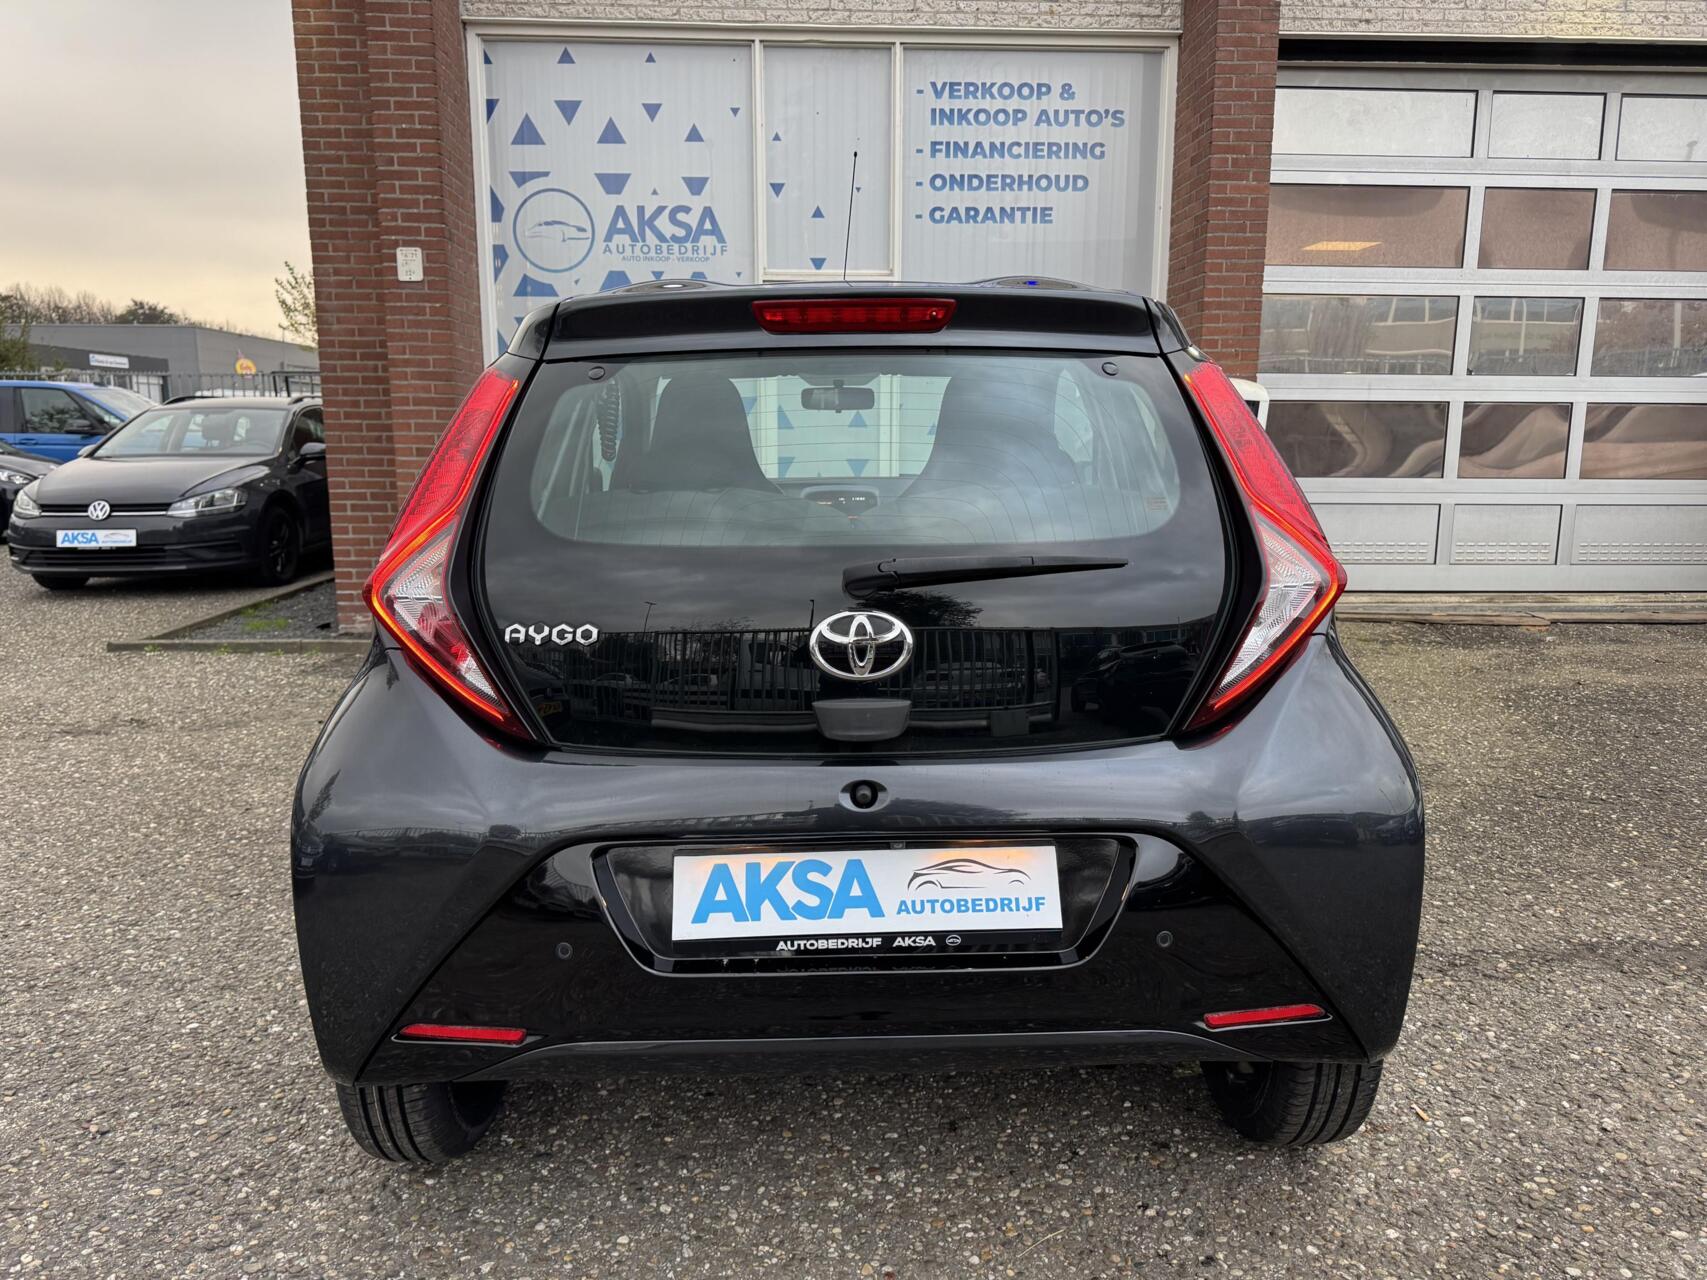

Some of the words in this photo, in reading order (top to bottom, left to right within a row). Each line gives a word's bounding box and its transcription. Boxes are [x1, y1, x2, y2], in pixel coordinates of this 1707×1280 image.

[929, 81, 1052, 101] VERKOOP
[1058, 82, 1076, 101] &
[930, 107, 1028, 126] INKOOP
[1034, 109, 1126, 128] AUTO'S
[929, 140, 1106, 160] FINANCIERING
[929, 173, 1090, 192] ONDERHOUD
[603, 204, 728, 244] AKSA
[928, 206, 1054, 225] GARANTIE
[602, 243, 728, 257] AUTOBEDRIJF
[642, 255, 671, 263] INKOOP
[60, 532, 100, 545] AKSA
[504, 623, 599, 646] AYGO
[690, 858, 885, 924] AKSA
[896, 896, 1046, 915] AUTOBEDRIJF
[775, 937, 883, 951] AUTOBEDRIJF
[892, 936, 936, 948] AKSA
